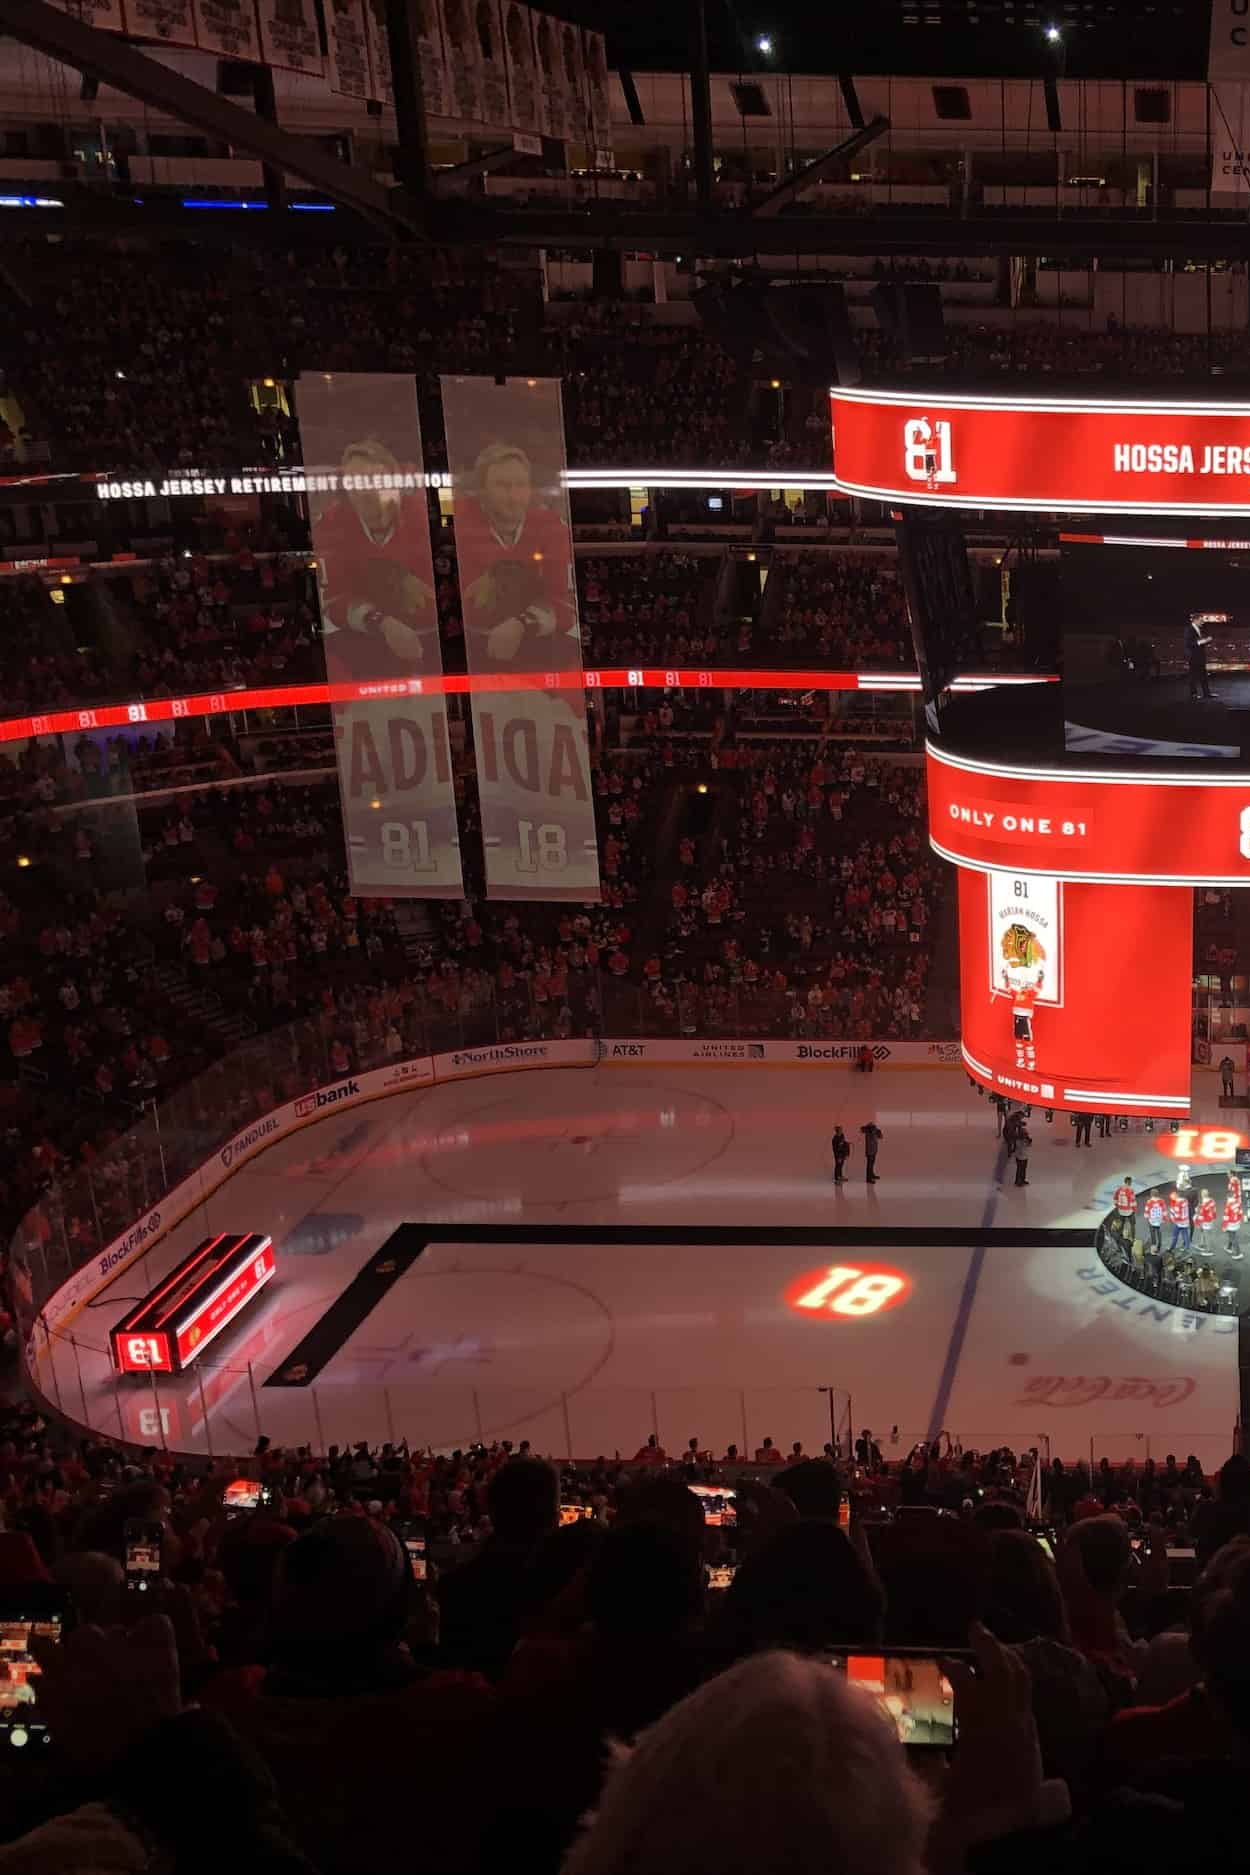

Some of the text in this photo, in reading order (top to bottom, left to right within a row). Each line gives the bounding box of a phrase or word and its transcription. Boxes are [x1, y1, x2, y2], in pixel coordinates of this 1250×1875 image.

[904, 417, 957, 484] 81
[1114, 443, 1194, 474] HOSSA
[97, 472, 454, 499] HOSSA JERSEY RETIREMENT CELEBRATION
[358, 682, 407, 695] UNITED
[586, 672, 601, 687] 81
[628, 671, 644, 686] 81
[666, 672, 680, 686] 81
[79, 711, 97, 729] 81
[128, 703, 148, 721] 81
[172, 699, 190, 717] 81
[949, 803, 1087, 836] ONLY ONE 81
[381, 820, 437, 873] 81
[1014, 880, 1029, 898] 81
[464, 1046, 547, 1064] NorthShore
[612, 1044, 646, 1057] AT&T
[797, 1045, 868, 1059] BlockFill
[316, 1081, 361, 1107] bank
[997, 1075, 1040, 1095] UNITED
[99, 1226, 149, 1276] BlockFills
[128, 1338, 163, 1365] 81
